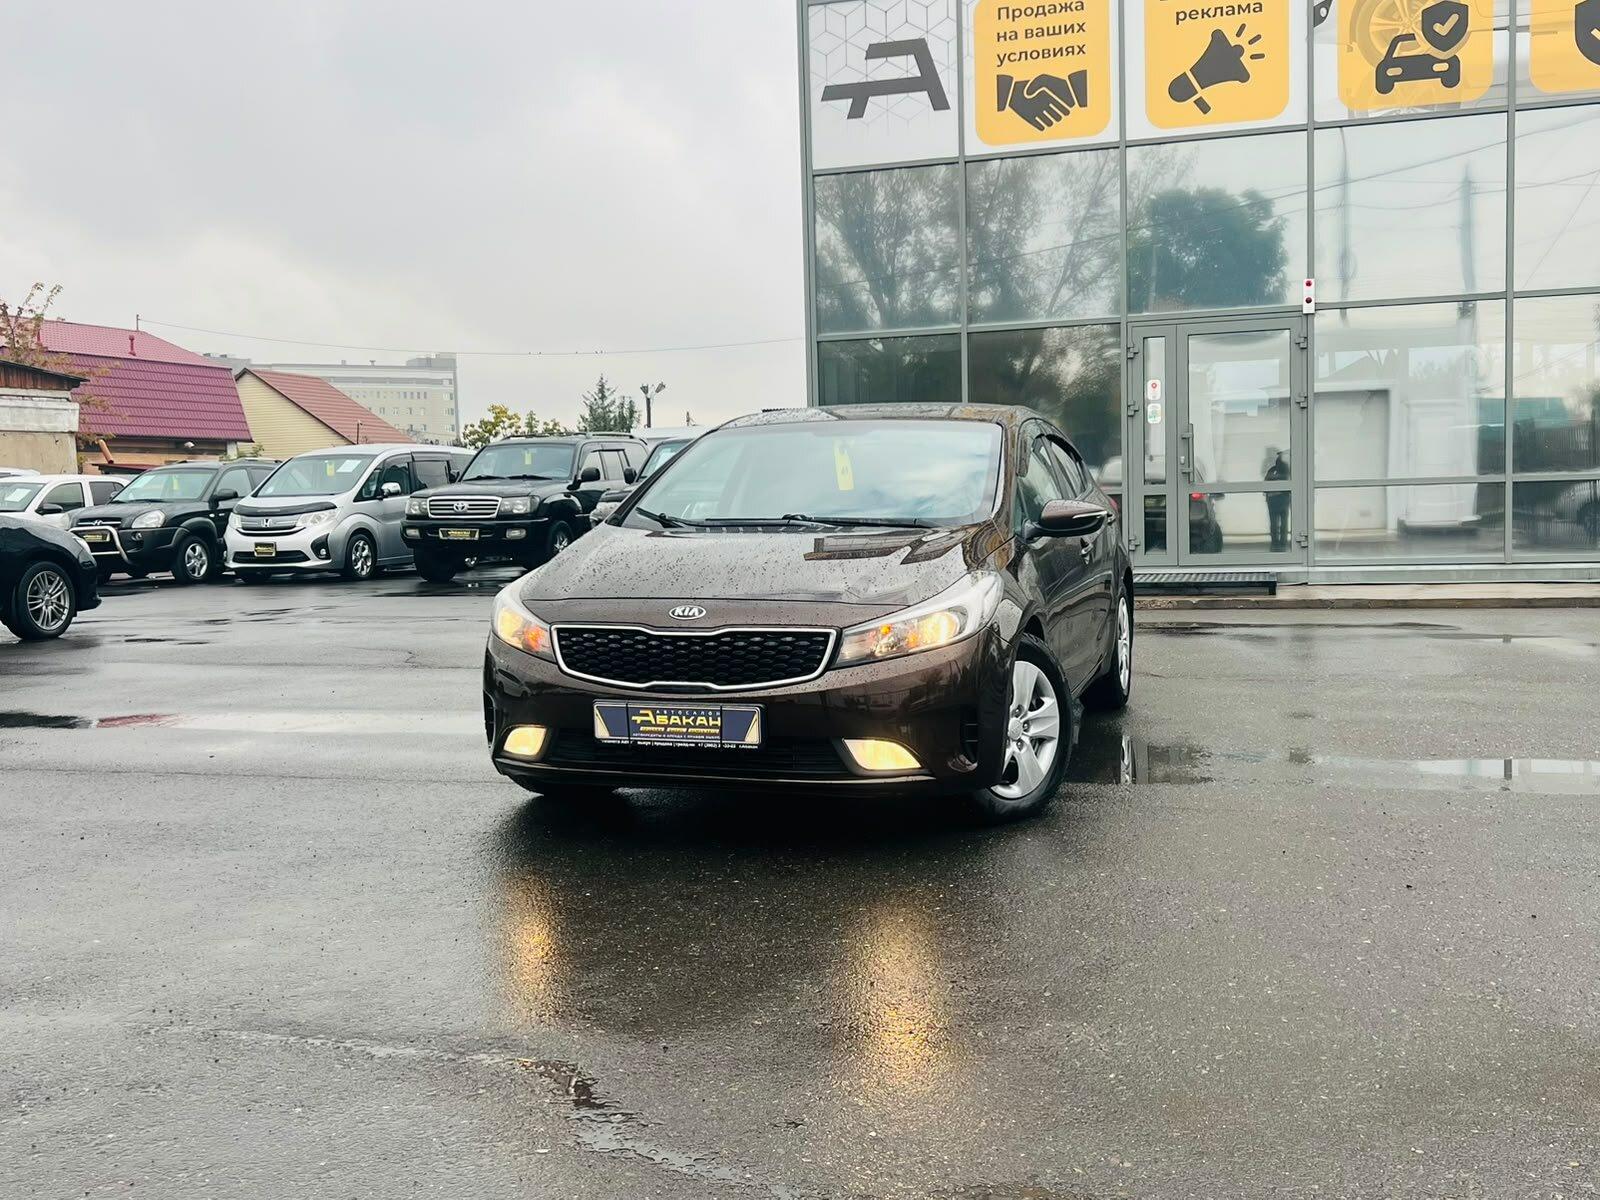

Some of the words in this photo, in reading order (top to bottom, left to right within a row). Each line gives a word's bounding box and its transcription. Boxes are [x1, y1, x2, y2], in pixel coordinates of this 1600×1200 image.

[997, 1, 1085, 22] Продажа
[1175, 2, 1263, 26] реклама
[996, 30, 1019, 43] на
[1024, 22, 1087, 40] ваших
[996, 44, 1087, 68] условиях
